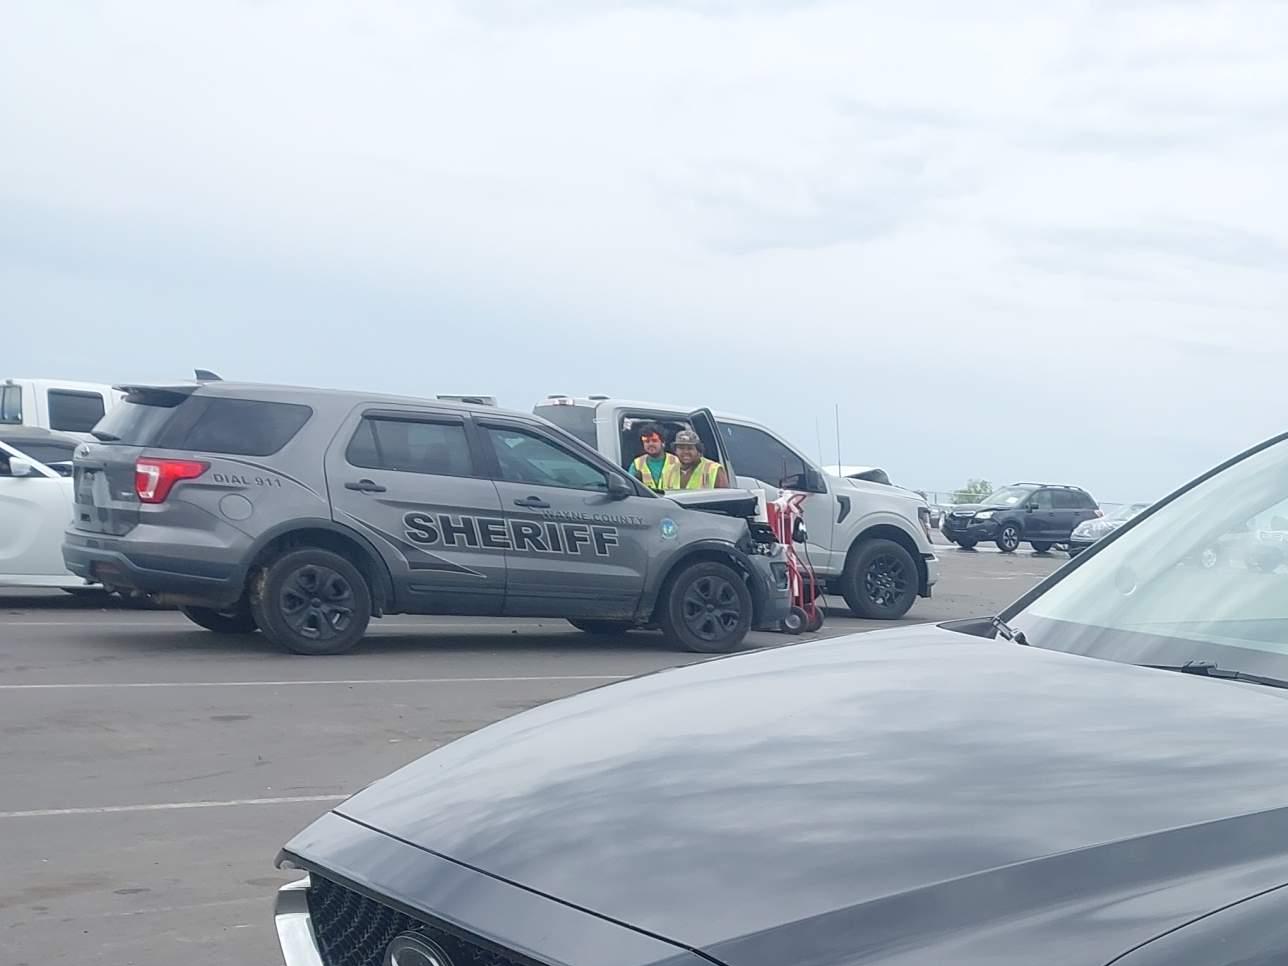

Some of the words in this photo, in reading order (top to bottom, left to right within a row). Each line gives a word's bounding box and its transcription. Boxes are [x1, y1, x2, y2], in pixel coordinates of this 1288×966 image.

[213, 473, 250, 485] DIAL
[255, 477, 282, 488] 911
[541, 510, 590, 522] WAYNE
[592, 512, 644, 525] COUNTY
[402, 510, 619, 557] SHERIFF
